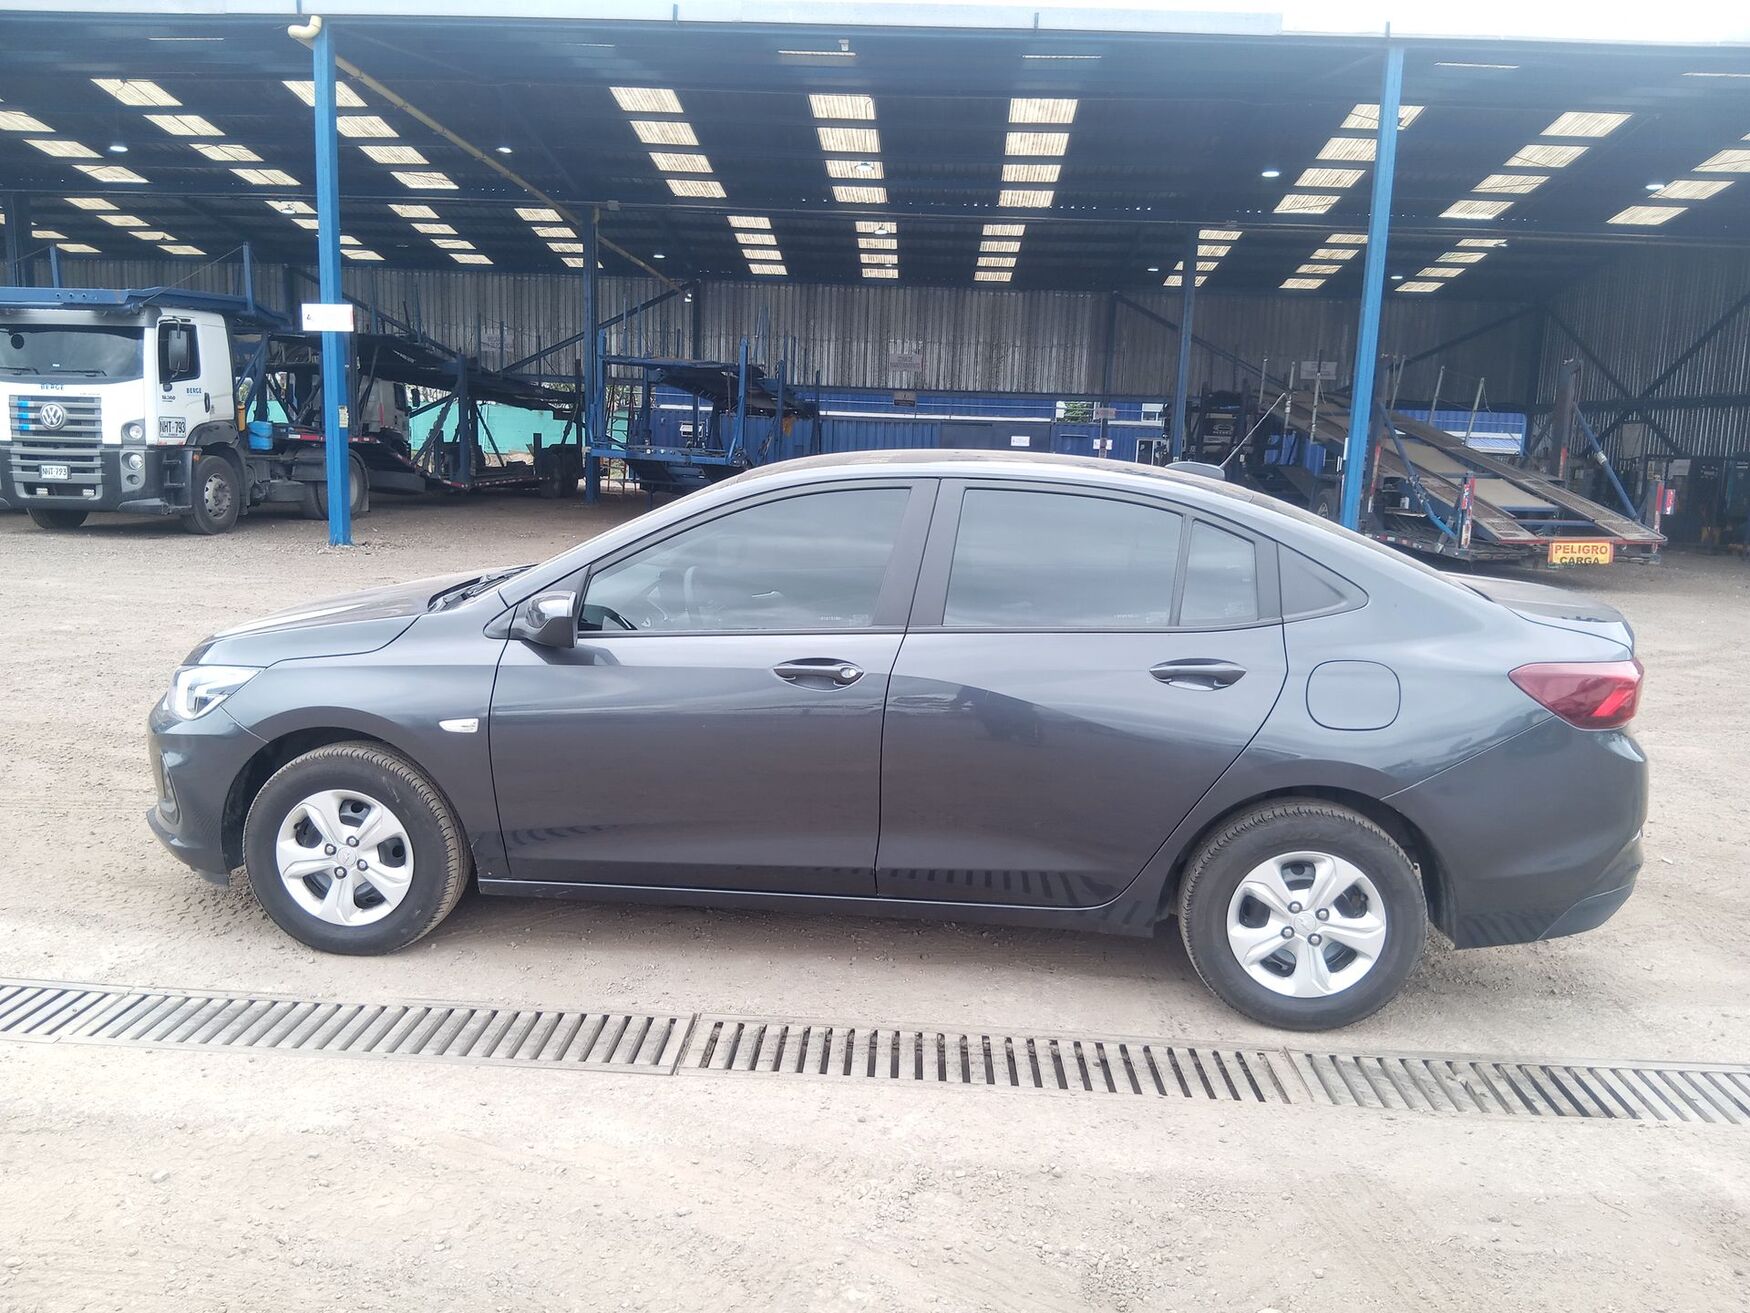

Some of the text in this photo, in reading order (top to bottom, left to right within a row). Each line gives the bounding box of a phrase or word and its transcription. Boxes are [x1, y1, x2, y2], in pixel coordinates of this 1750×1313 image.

[160, 421, 186, 433] NHT-793
[42, 467, 67, 476] NHT-793
[1555, 544, 1608, 555] PELIGRO
[1560, 556, 1600, 566] CARGA
